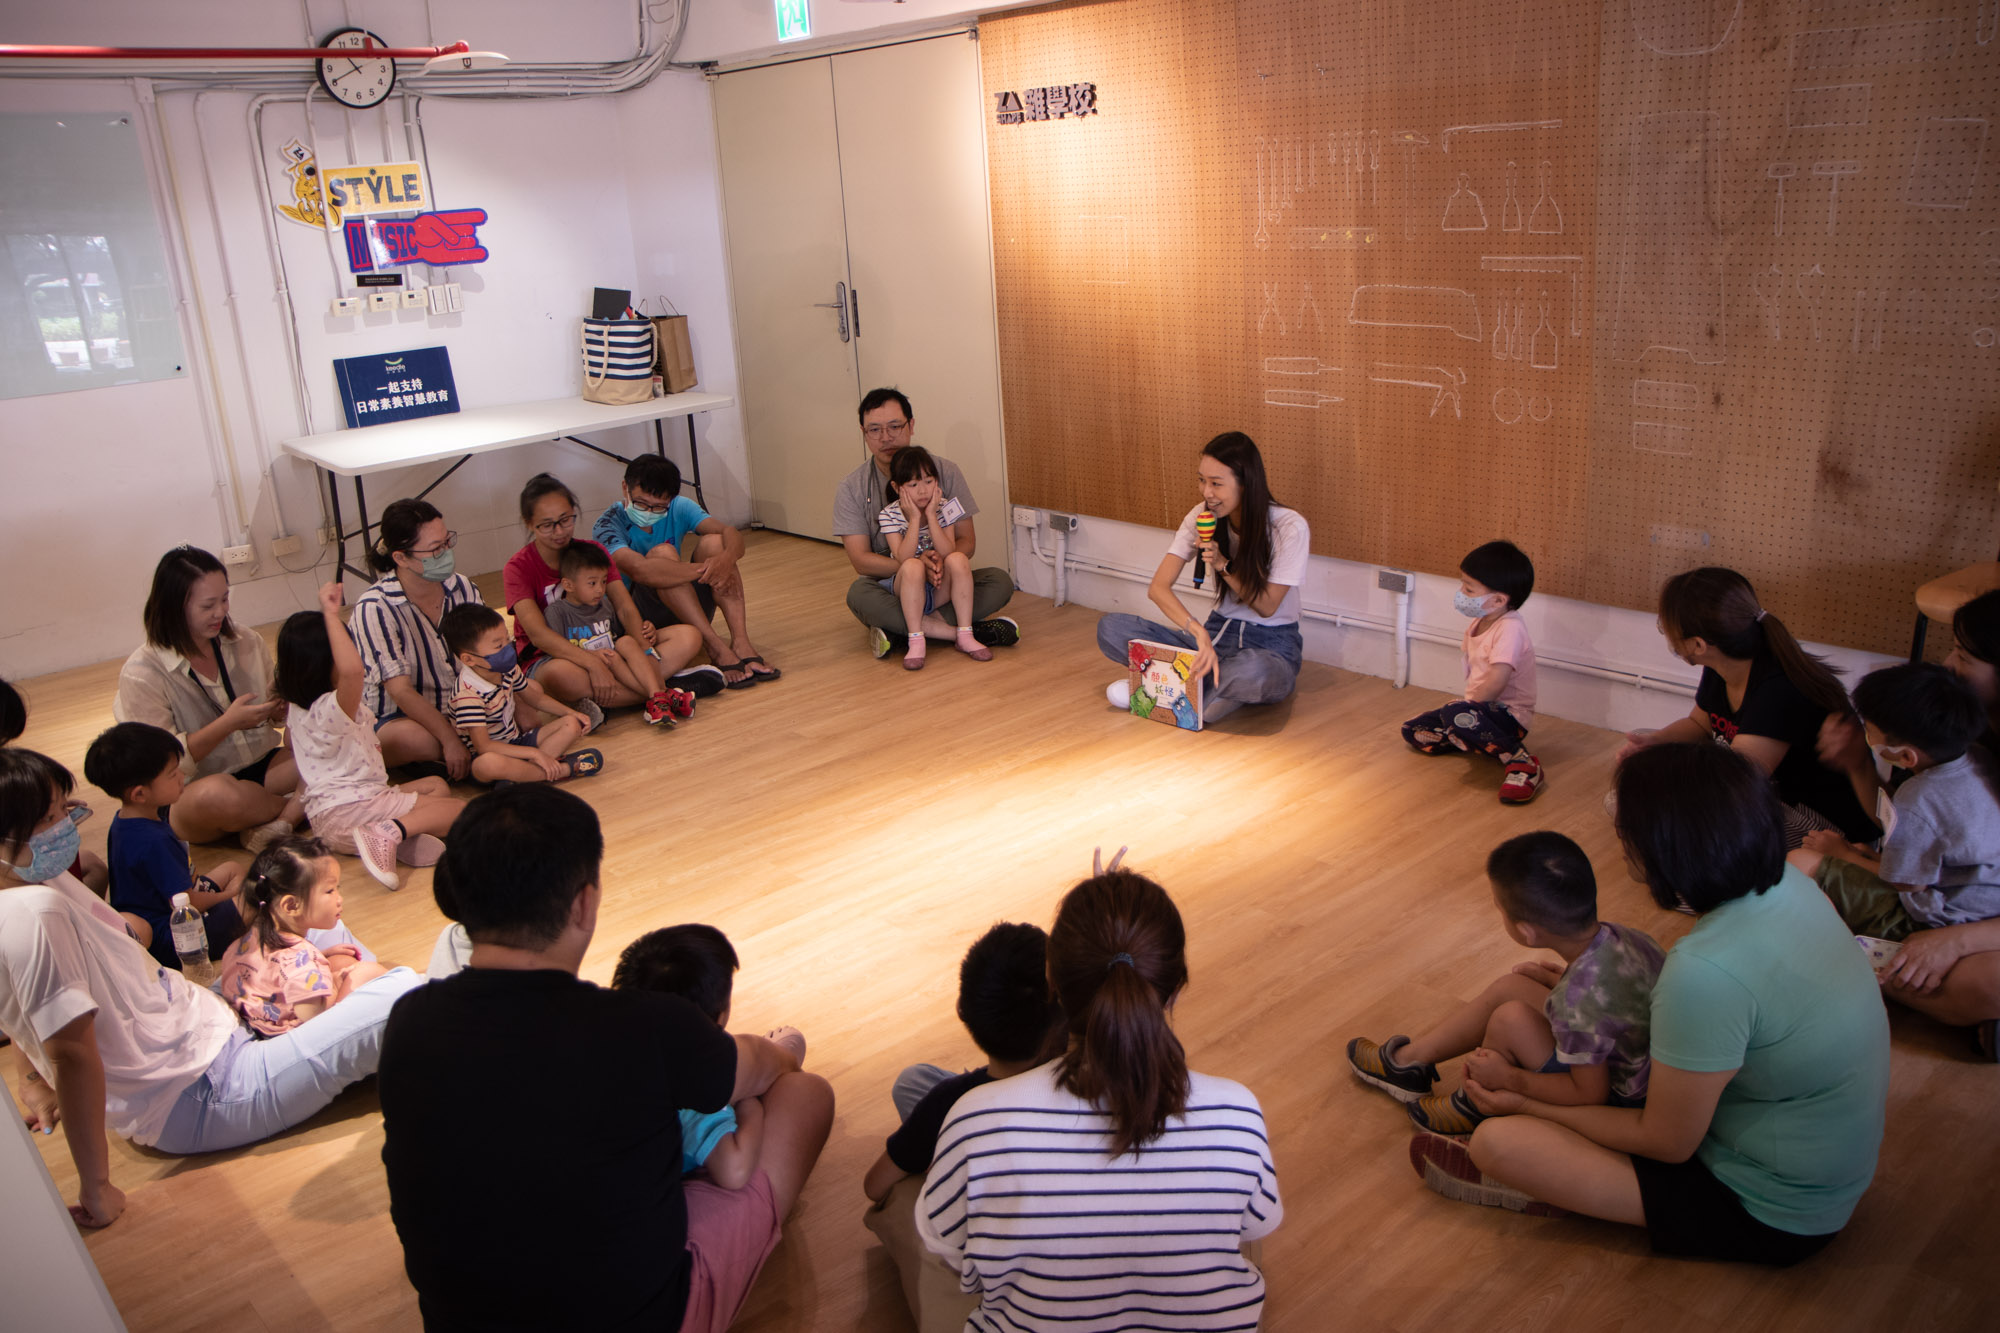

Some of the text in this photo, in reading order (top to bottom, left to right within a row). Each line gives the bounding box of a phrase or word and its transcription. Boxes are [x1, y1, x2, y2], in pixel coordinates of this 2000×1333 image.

[350, 37, 359, 46] 12
[327, 65, 333, 73] 9
[380, 65, 386, 73] 3
[378, 78, 383, 86] 4
[343, 88, 348, 96] 7
[356, 92, 362, 100] 6
[369, 88, 375, 96] 5
[1024, 82, 1095, 121] 雜學校
[329, 173, 421, 207] STYLE
[376, 378, 423, 394] 一起支持
[356, 389, 449, 414] 日常素養智慧教育
[568, 625, 593, 640] I'M
